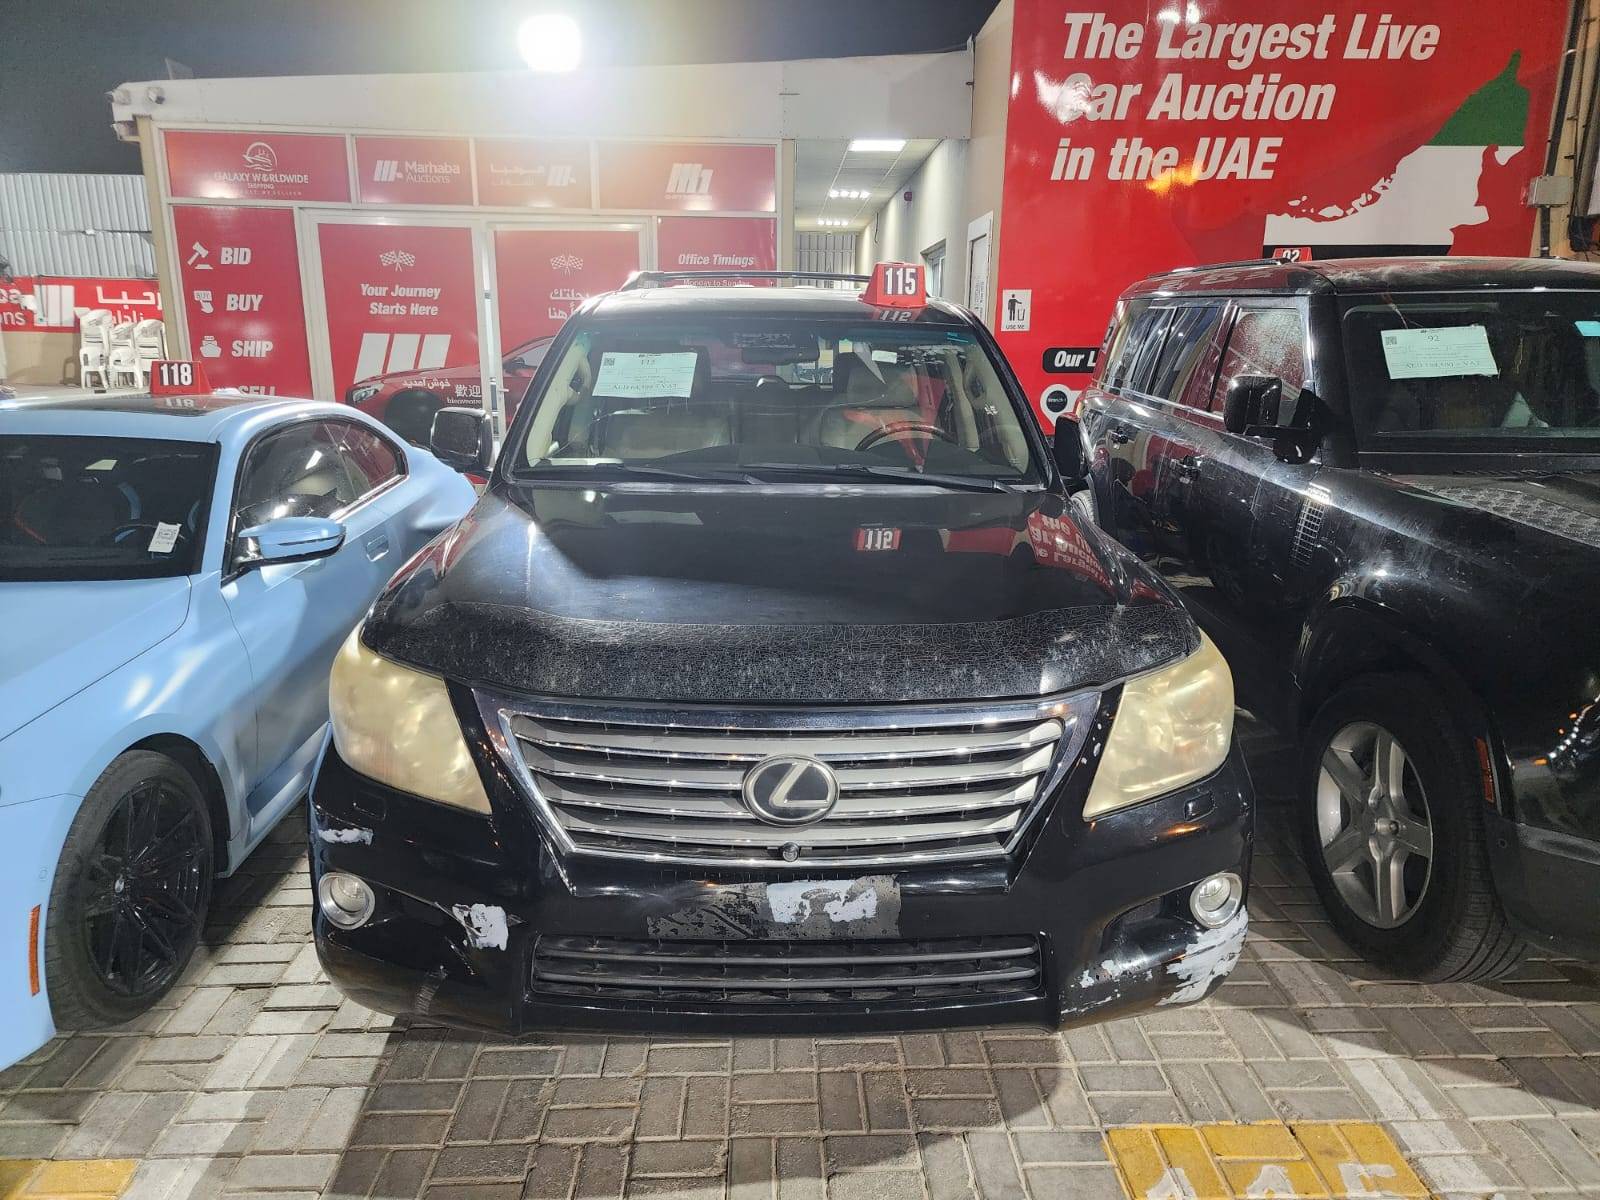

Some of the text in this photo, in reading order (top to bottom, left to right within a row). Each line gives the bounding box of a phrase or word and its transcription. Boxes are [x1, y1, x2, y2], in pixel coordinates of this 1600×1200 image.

[1063, 12, 1440, 71] The Largest Live
[1060, 72, 1337, 122] Car Auction
[1050, 137, 1283, 181] in the UAE
[404, 161, 460, 175] Marhaba
[406, 174, 450, 184] Auctions
[220, 247, 251, 265] BID
[678, 254, 754, 267] Office Timings
[886, 268, 916, 294] 115
[361, 284, 441, 299] Your Journey
[226, 294, 263, 311] BUY
[370, 302, 438, 315] Starts Here
[231, 340, 273, 358] SHIP
[1054, 350, 1097, 367] Our L
[161, 363, 192, 386] 118
